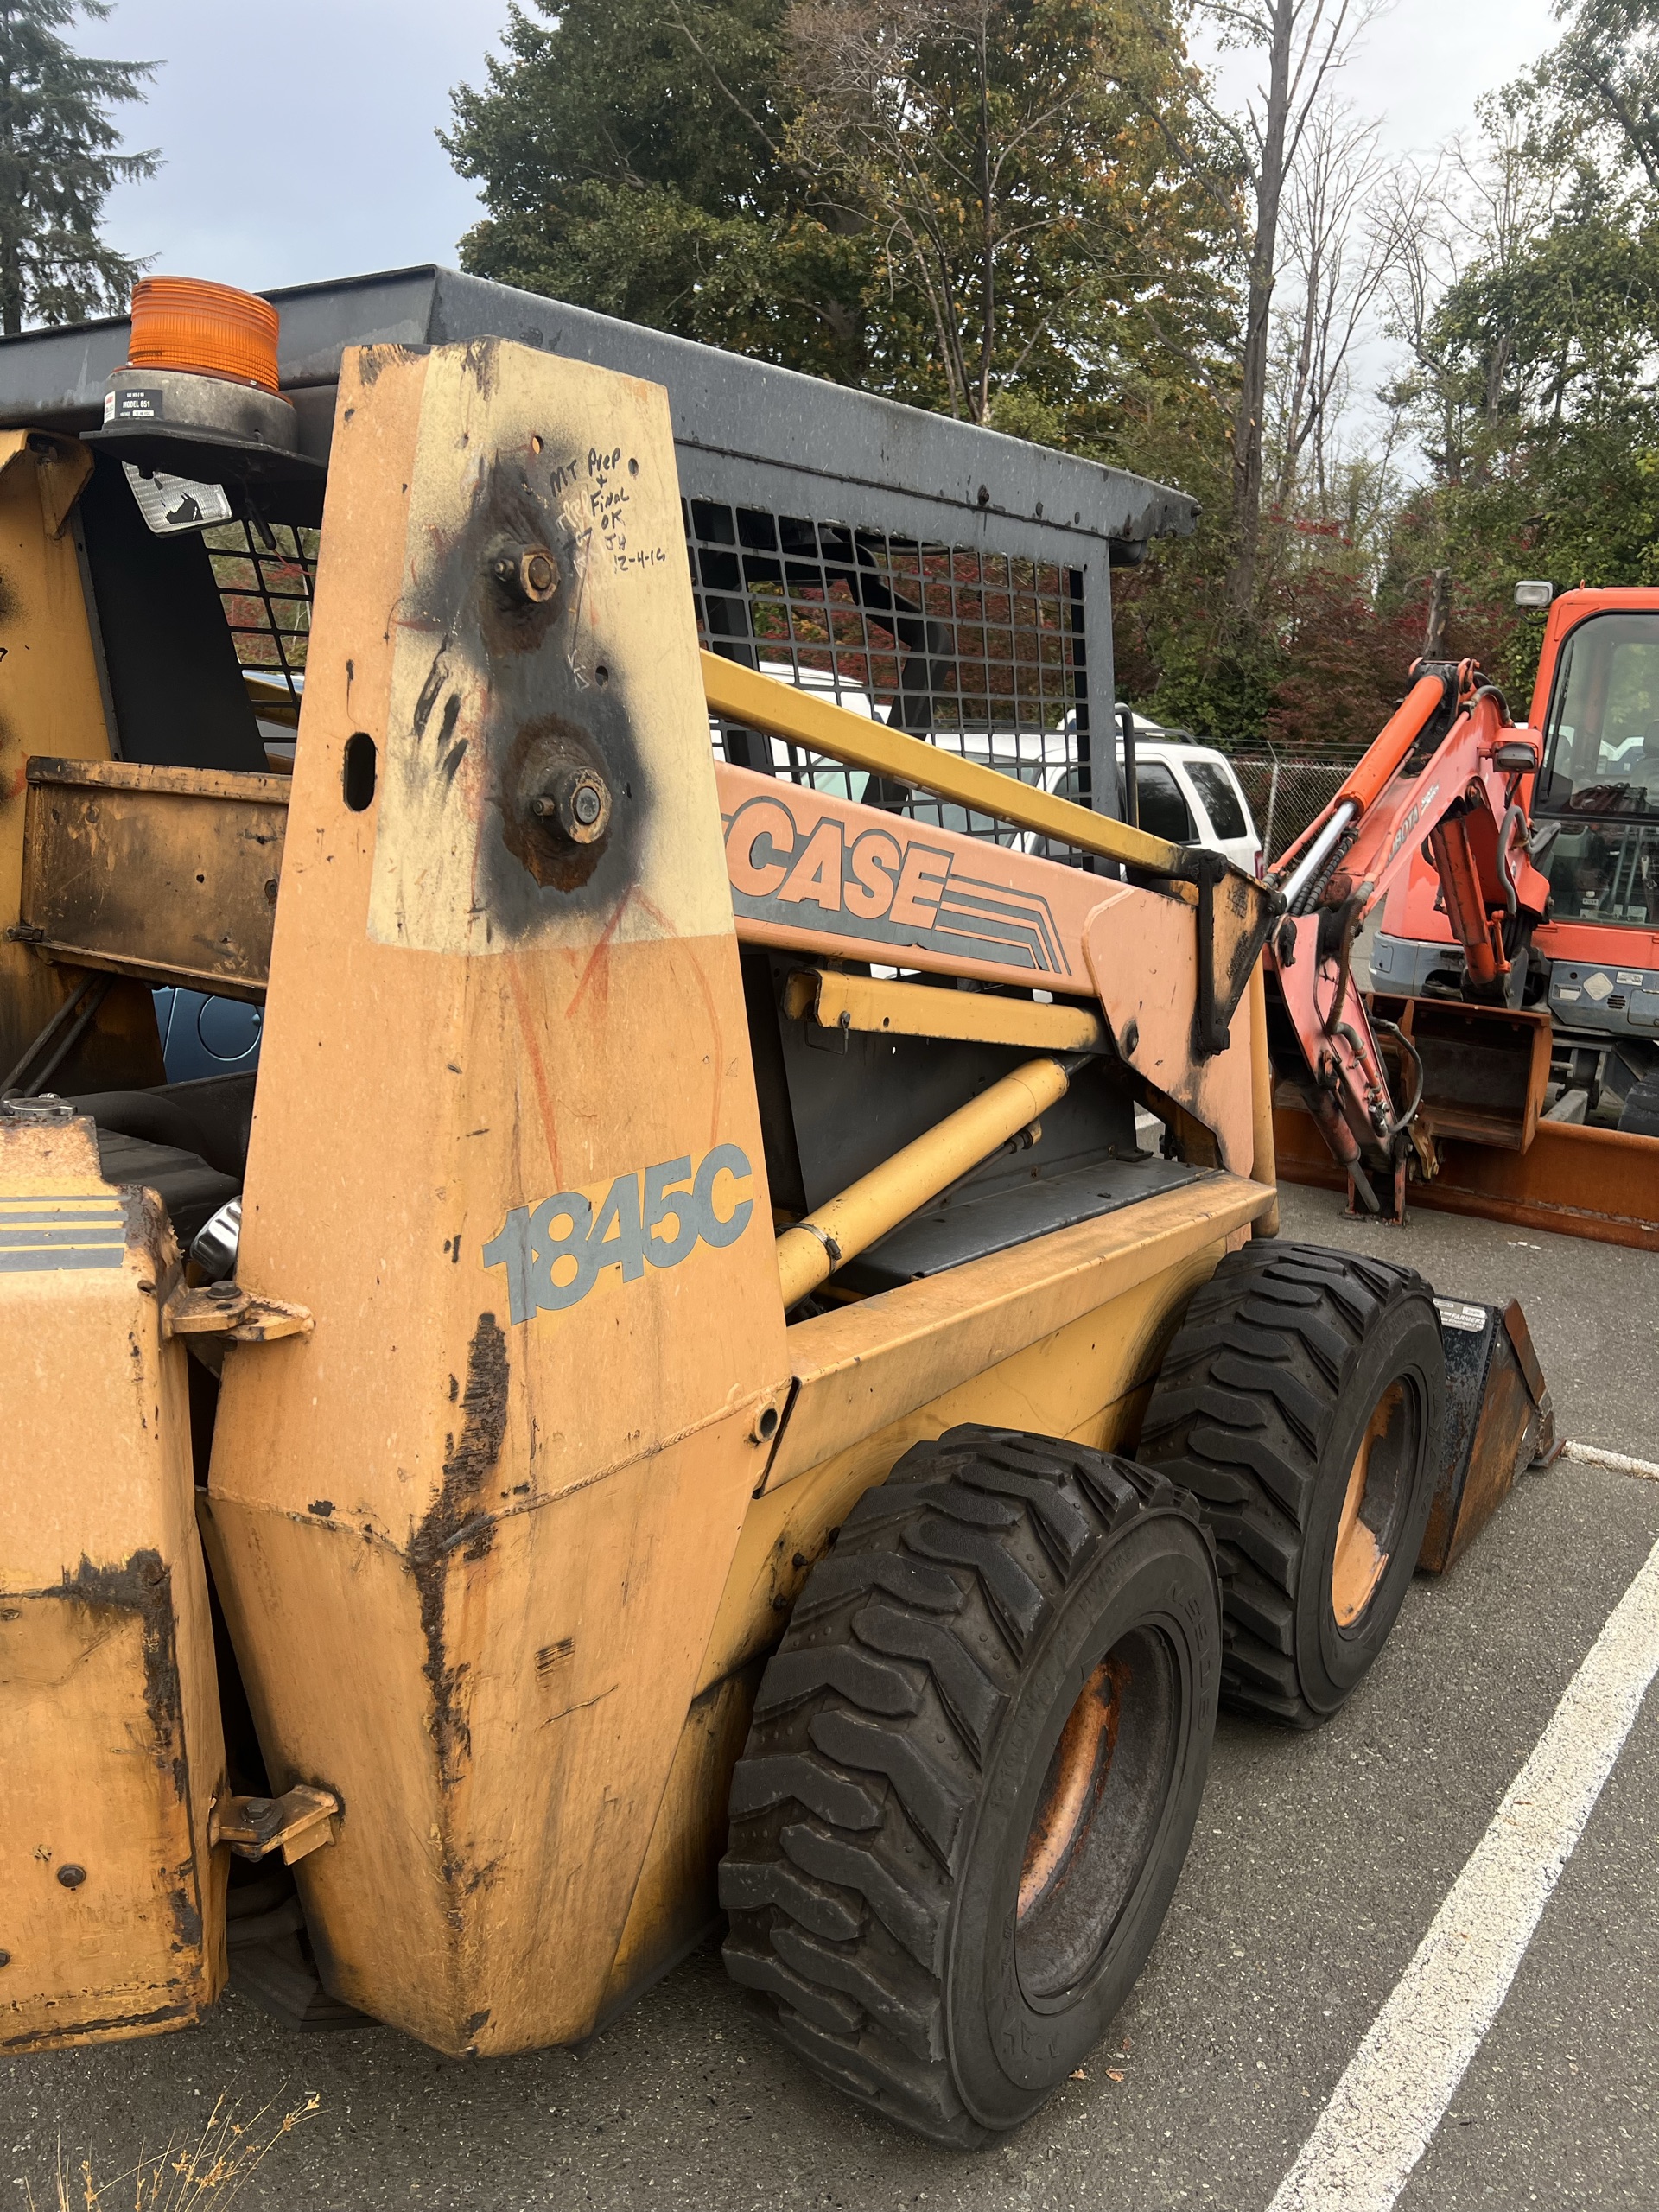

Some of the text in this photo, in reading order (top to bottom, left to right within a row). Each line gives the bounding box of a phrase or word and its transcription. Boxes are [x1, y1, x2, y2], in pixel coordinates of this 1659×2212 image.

[725, 798, 952, 930] CASE
[482, 1143, 753, 1326] 1845C
[1452, 1313, 1486, 1325] FARMERS
